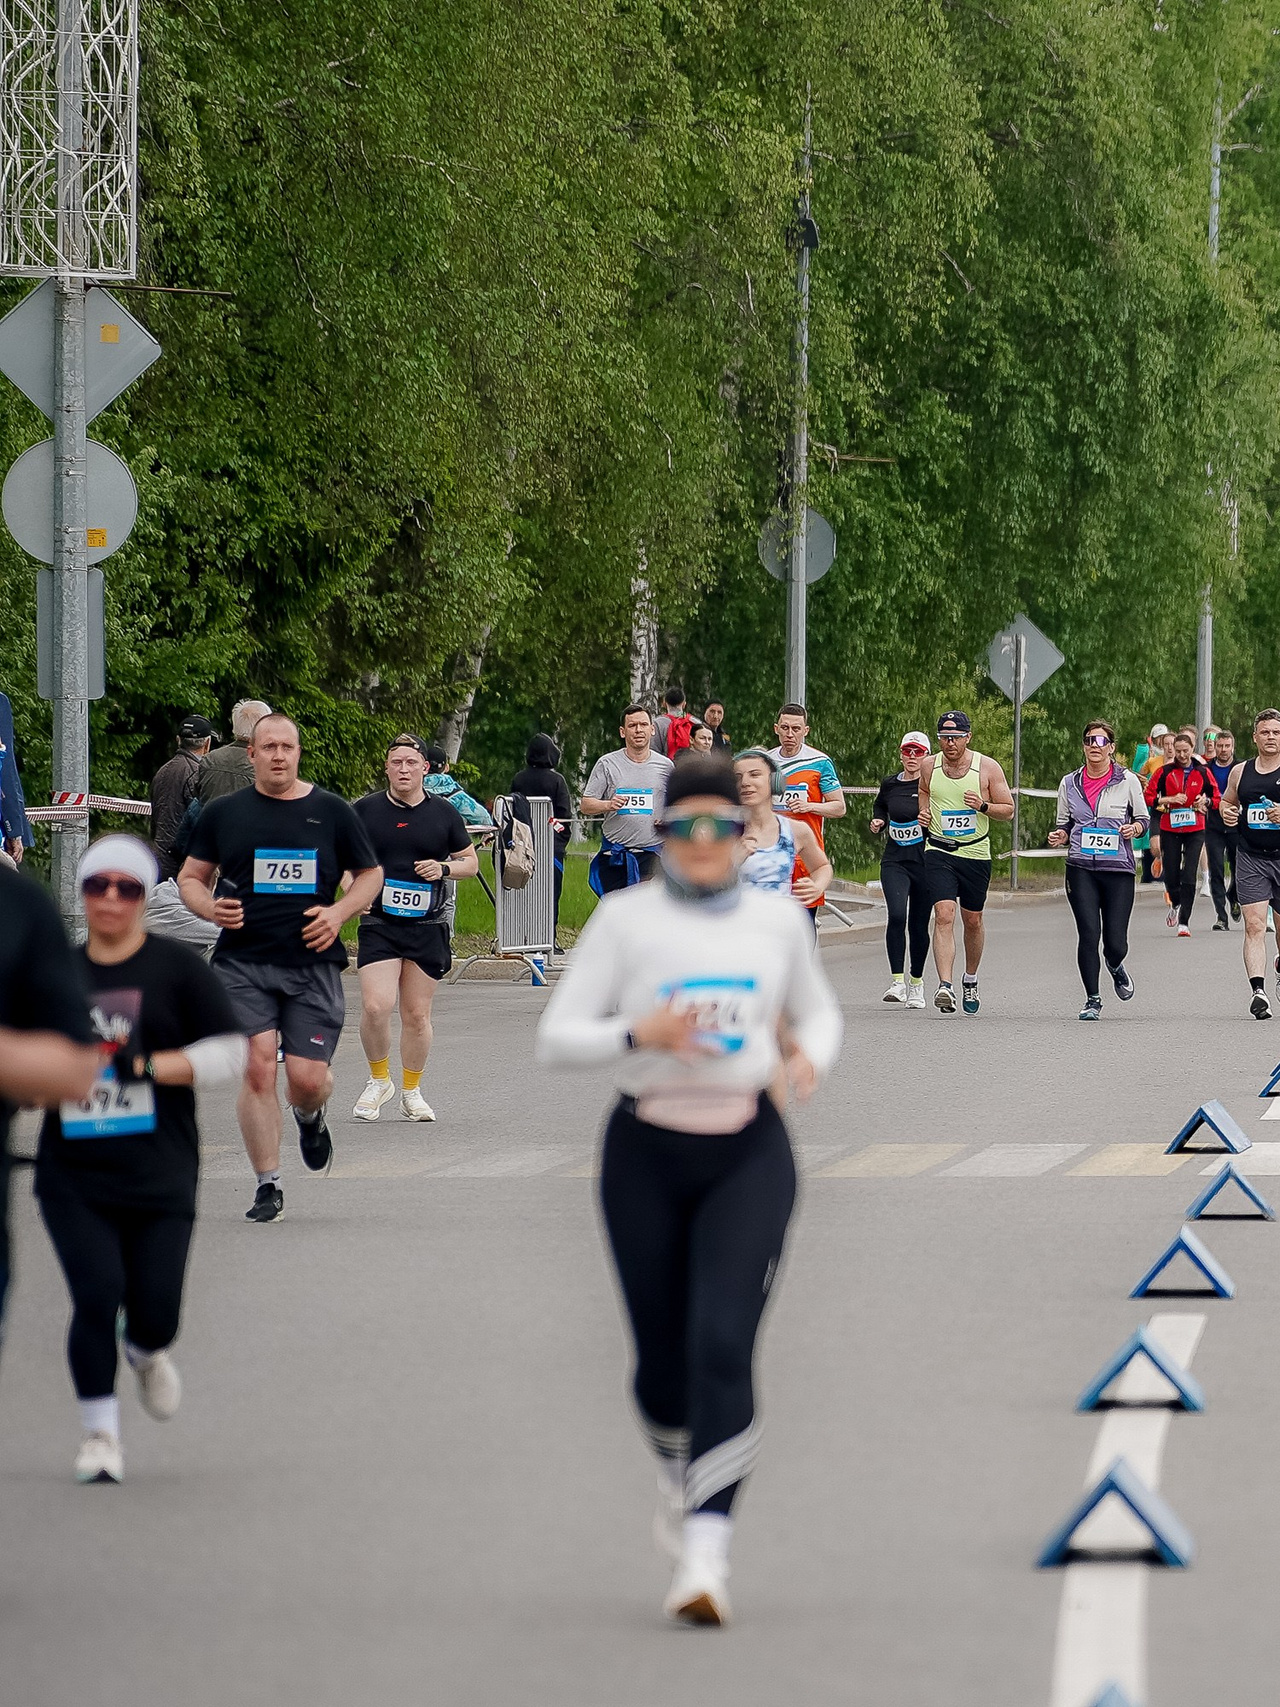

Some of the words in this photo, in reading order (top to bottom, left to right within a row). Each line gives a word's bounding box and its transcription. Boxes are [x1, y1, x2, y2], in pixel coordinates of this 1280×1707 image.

[624, 796, 645, 806] 755
[947, 817, 970, 828] 752
[892, 827, 919, 839] 1096
[1089, 835, 1111, 847] 754
[266, 863, 303, 880] 765
[392, 890, 421, 907] 550
